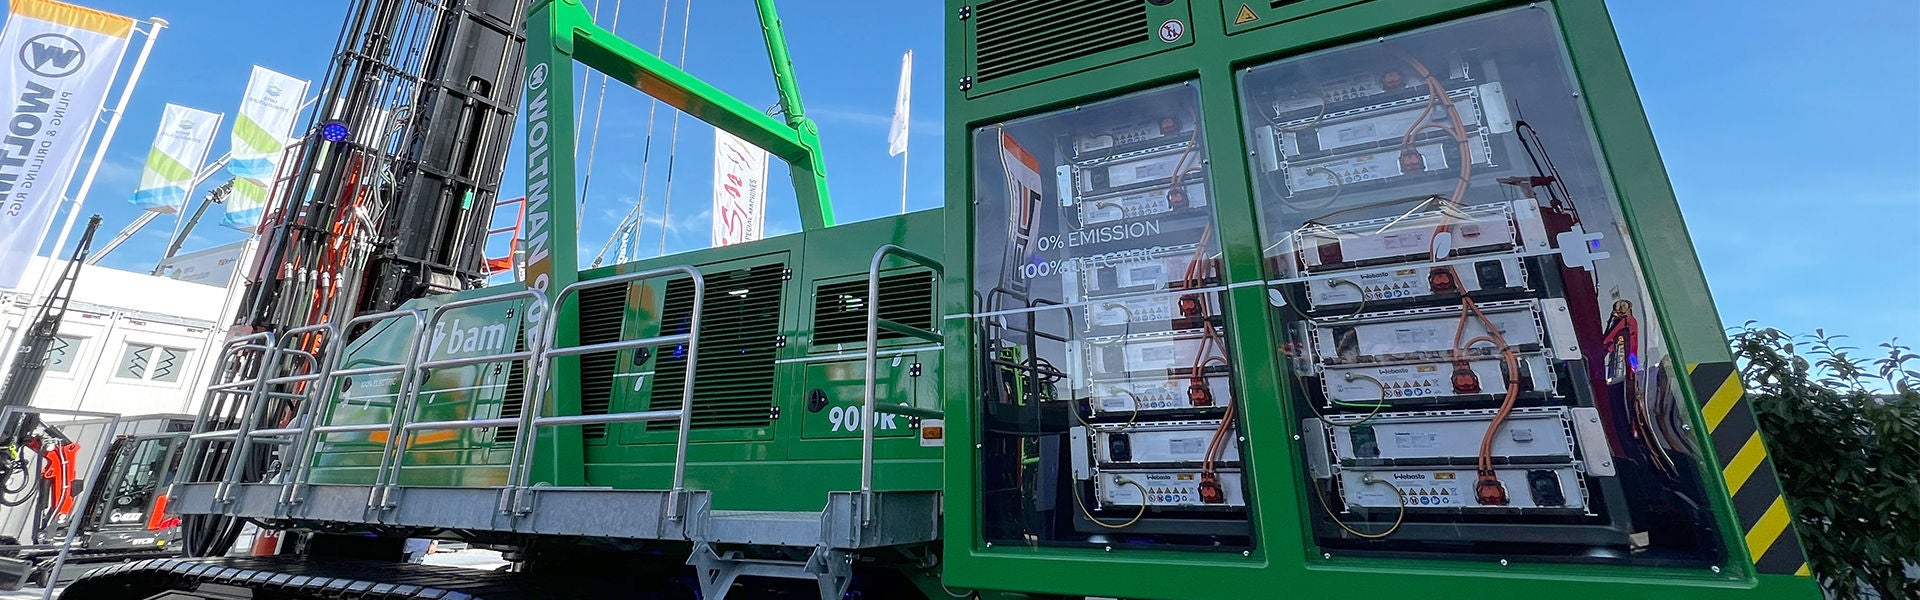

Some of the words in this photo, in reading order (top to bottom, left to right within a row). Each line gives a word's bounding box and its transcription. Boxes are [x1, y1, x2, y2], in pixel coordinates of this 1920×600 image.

[528, 87, 549, 267] WOLTMAN
[1038, 234, 1065, 251] 0%
[1068, 219, 1161, 248] EMISSION
[1018, 259, 1064, 280] 100%
[1070, 245, 1162, 272] ELECTRIC
[447, 319, 507, 355] bam
